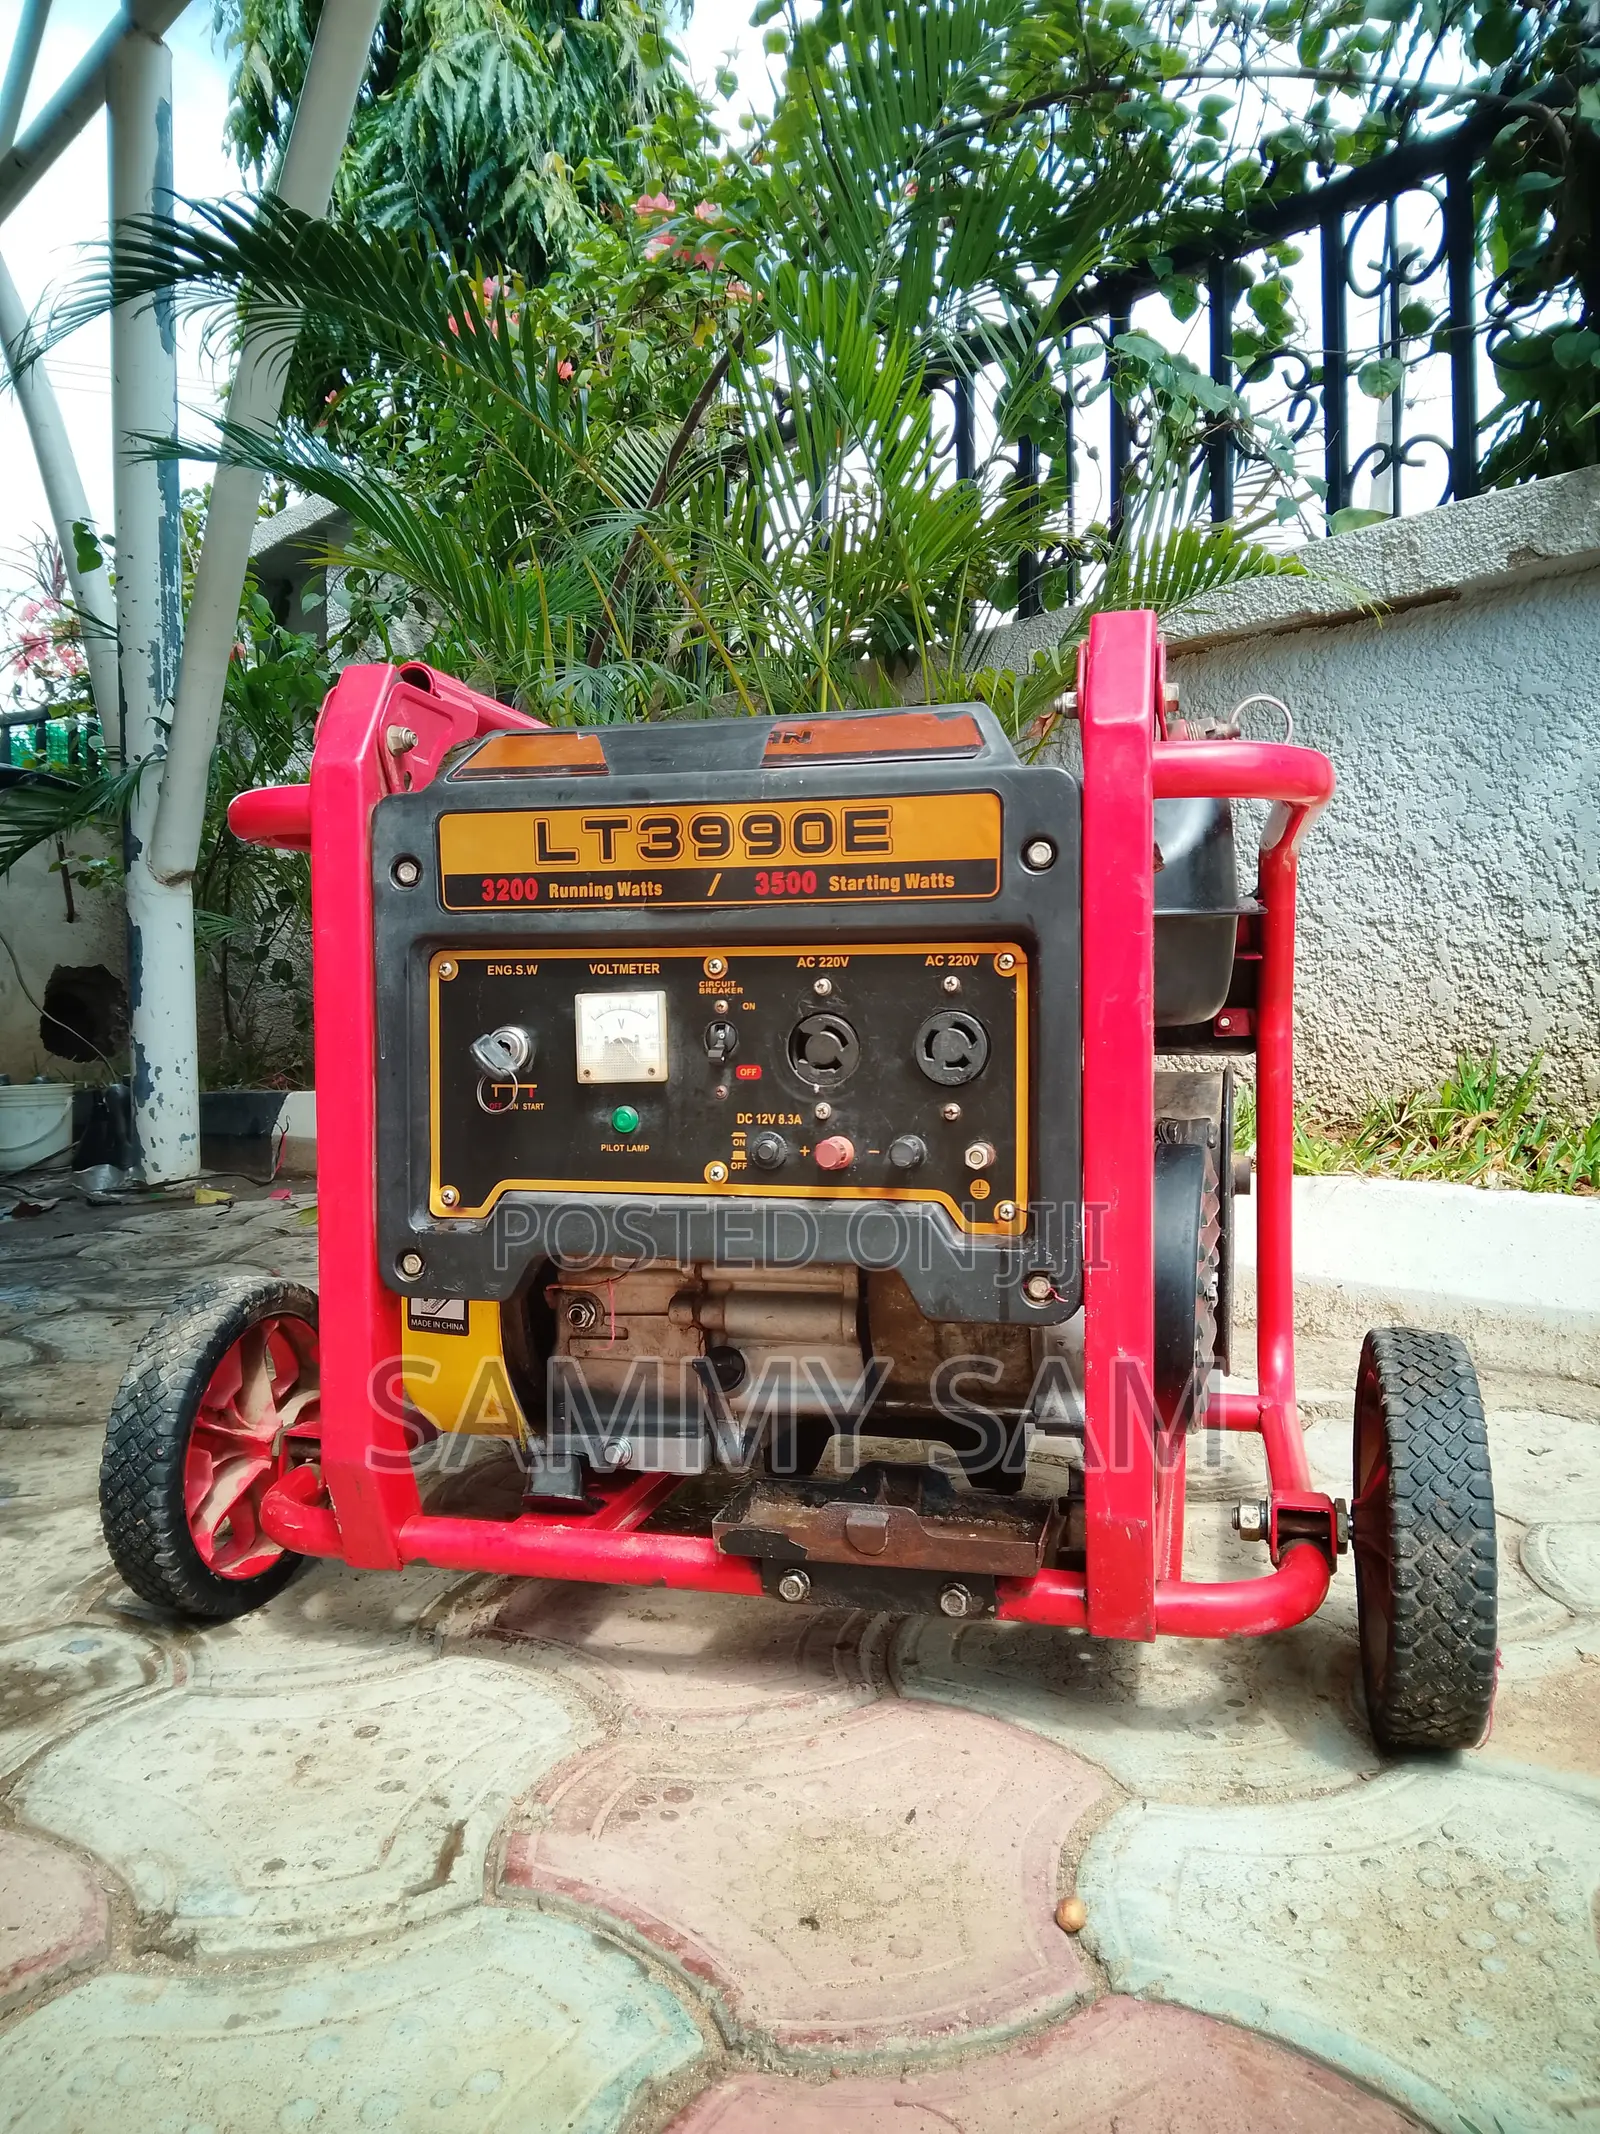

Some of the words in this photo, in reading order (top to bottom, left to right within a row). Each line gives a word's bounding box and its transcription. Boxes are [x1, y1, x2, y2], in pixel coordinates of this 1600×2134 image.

[533, 805, 893, 865] LT3990E
[481, 878, 538, 901] 3200
[549, 881, 613, 900] Running
[617, 881, 663, 897] Watts
[707, 872, 721, 897] /
[754, 870, 817, 895] 3500
[829, 874, 900, 893] Starting
[904, 873, 955, 890] Watts
[796, 956, 815, 968] AC
[818, 956, 850, 968] 220V
[924, 955, 944, 967] AC
[947, 955, 979, 967] 220V
[487, 964, 538, 976] ENG.S.W
[589, 963, 660, 975] VOLTMETER
[698, 980, 737, 988] CIRCUIT
[698, 986, 744, 995] BREAKER
[742, 1002, 756, 1011] ON
[739, 1067, 758, 1077] OFF
[489, 1102, 503, 1110] OFF
[522, 1102, 545, 1111] START
[736, 1113, 753, 1125] DC
[755, 1113, 776, 1125] 12V
[778, 1113, 802, 1125] 8.3A
[600, 1143, 625, 1152] PILOT
[626, 1144, 650, 1152] LAMP
[732, 1138, 746, 1147] ON
[730, 1161, 748, 1170] OFF
[411, 1319, 431, 1328] MADE
[441, 1322, 464, 1331] CHINA
